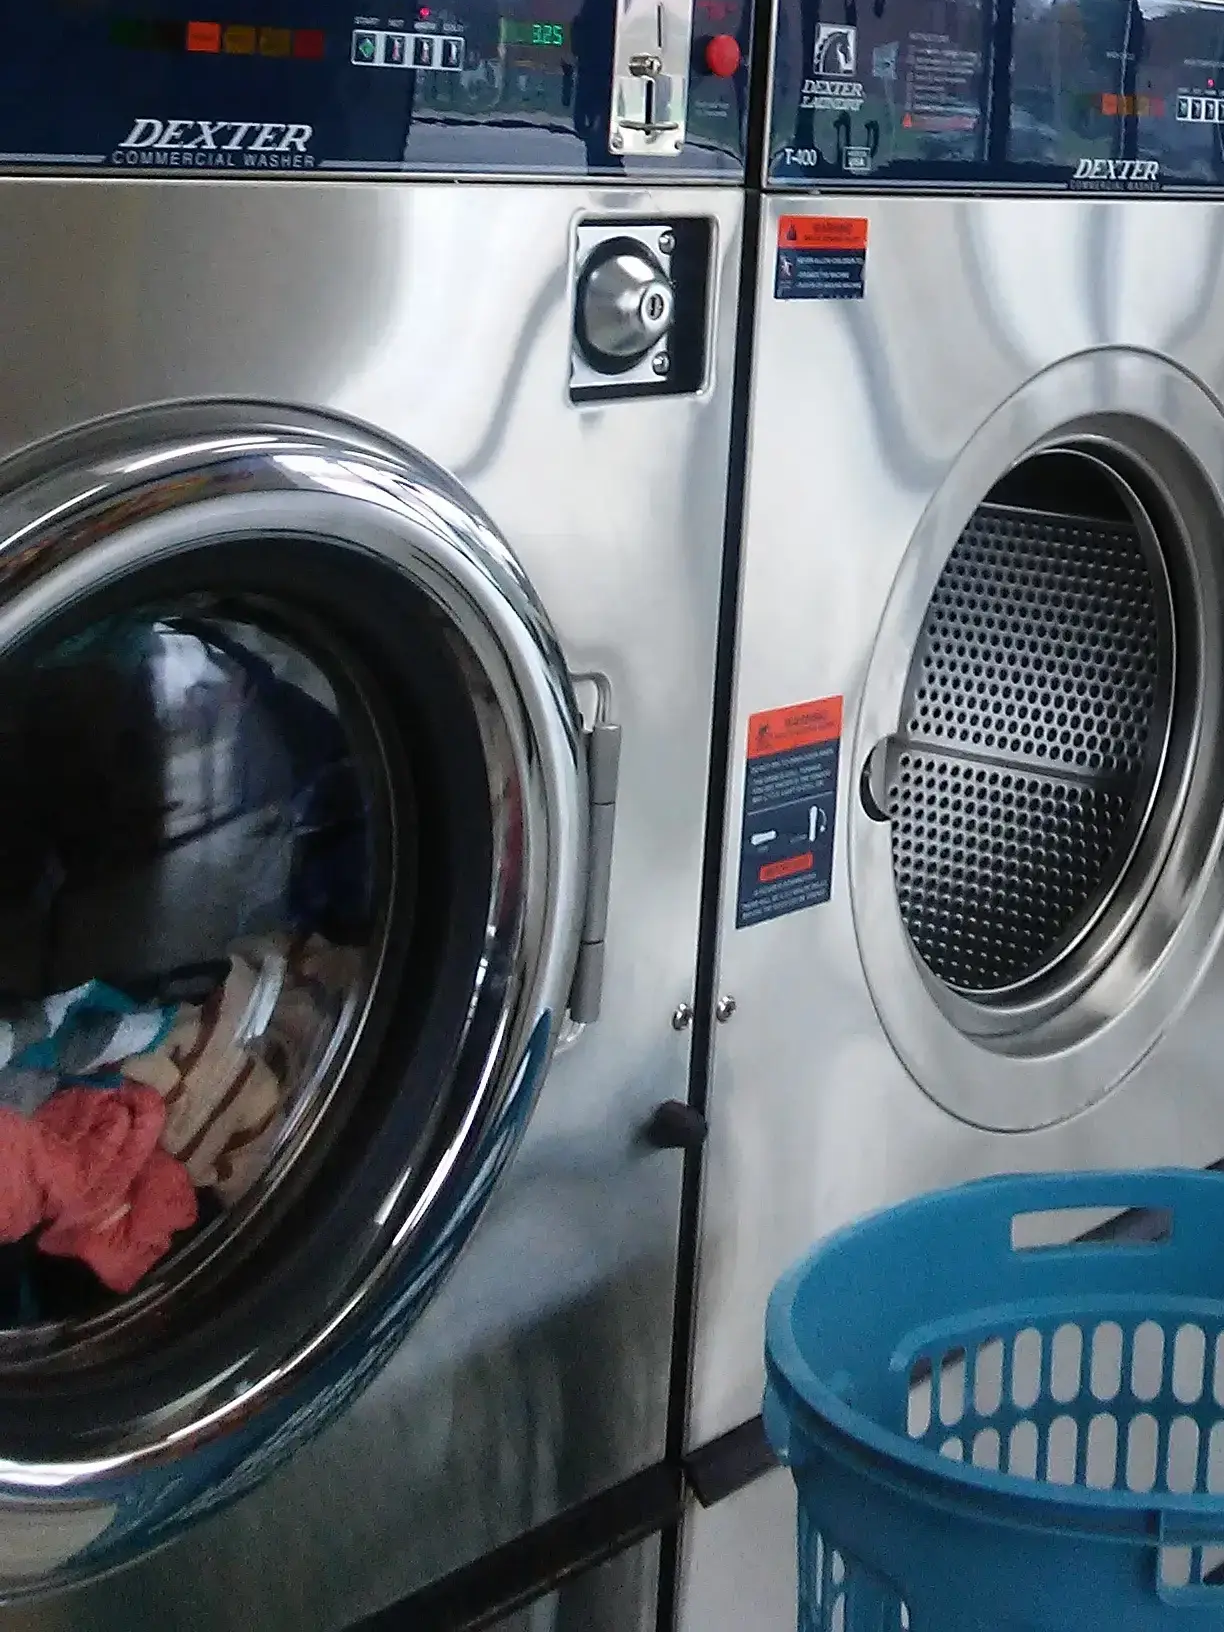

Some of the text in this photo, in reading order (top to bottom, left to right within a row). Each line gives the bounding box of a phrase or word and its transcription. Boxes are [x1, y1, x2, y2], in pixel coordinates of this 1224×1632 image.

[801, 79, 864, 97] DEXTER
[117, 118, 314, 152] DEXTER
[111, 150, 316, 168] COMMERCIAL WASHER
[1072, 157, 1160, 181] DEXTER
